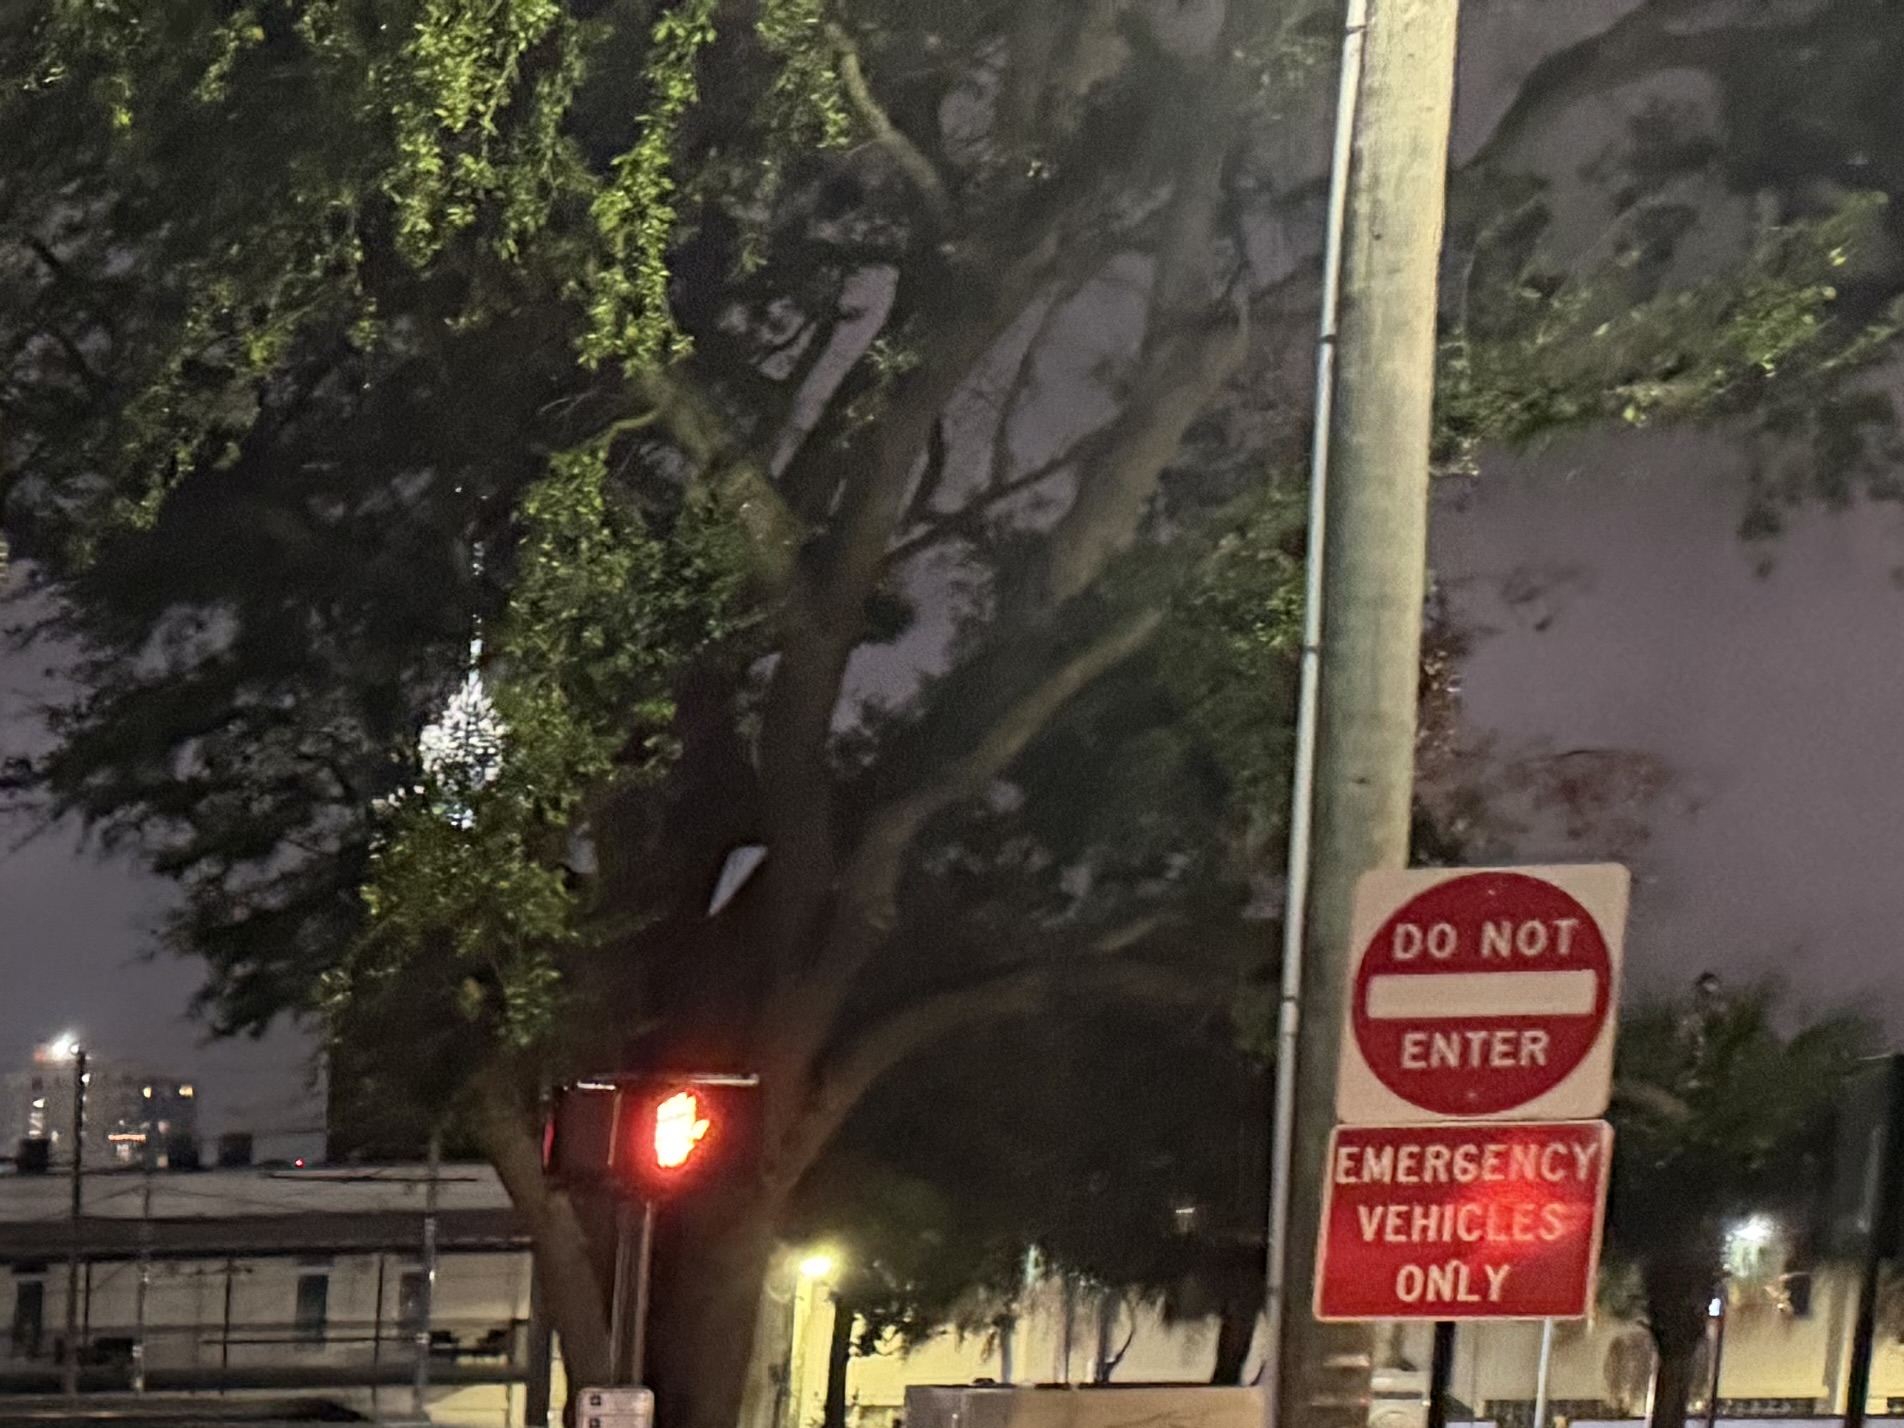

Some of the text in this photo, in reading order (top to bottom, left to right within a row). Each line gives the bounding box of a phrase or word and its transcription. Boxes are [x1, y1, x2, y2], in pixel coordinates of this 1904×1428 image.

[1392, 917, 1580, 962] DO NOT
[1400, 1029, 1551, 1070] ENTER
[1334, 1141, 1599, 1185] EMERGENCY
[1356, 1201, 1568, 1244] VEHICLES
[1395, 1260, 1512, 1303] ONLY
